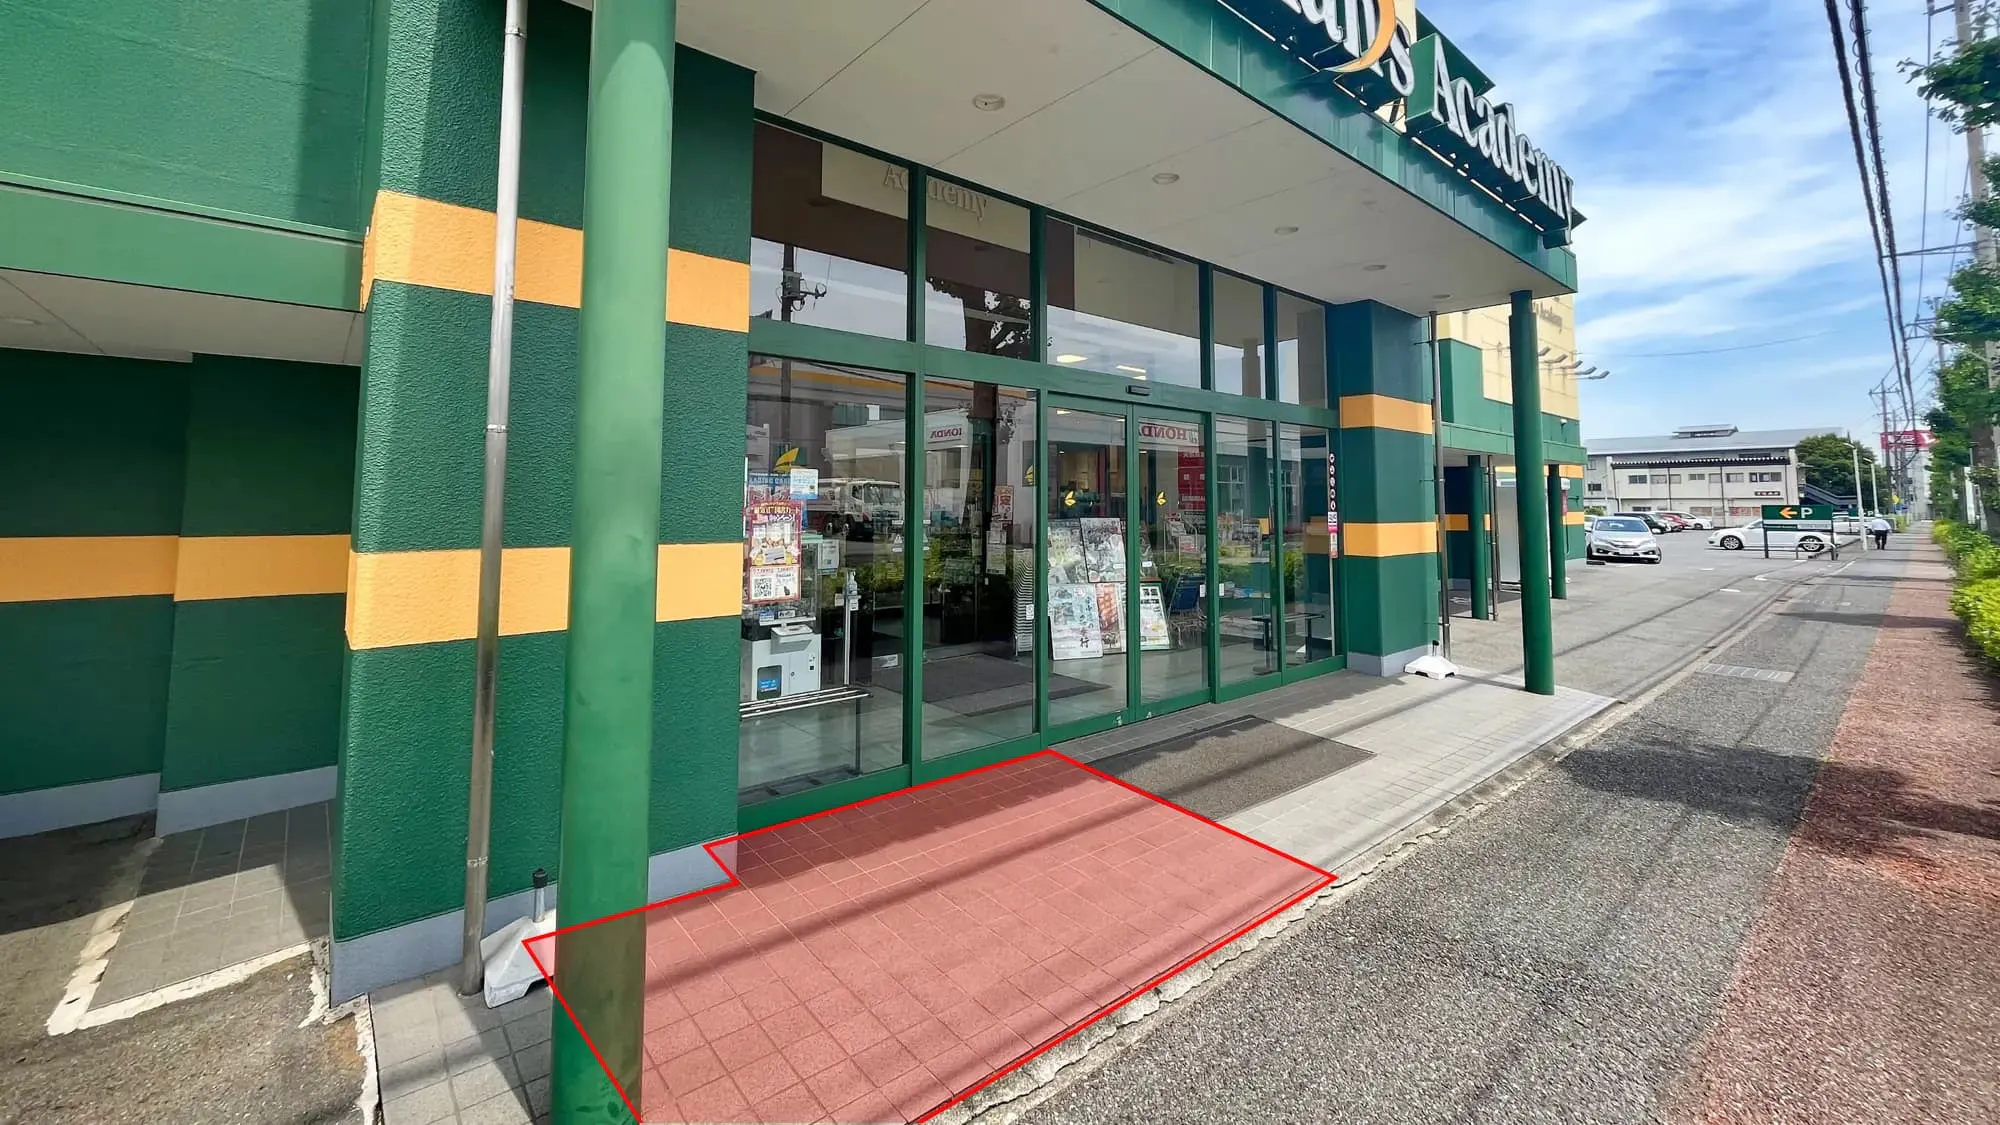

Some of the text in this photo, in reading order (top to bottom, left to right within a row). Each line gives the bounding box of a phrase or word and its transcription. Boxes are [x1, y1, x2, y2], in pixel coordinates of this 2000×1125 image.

[1431, 34, 1575, 244] Academy
[883, 164, 988, 222] Acdemy
[1800, 507, 1813, 519] P
